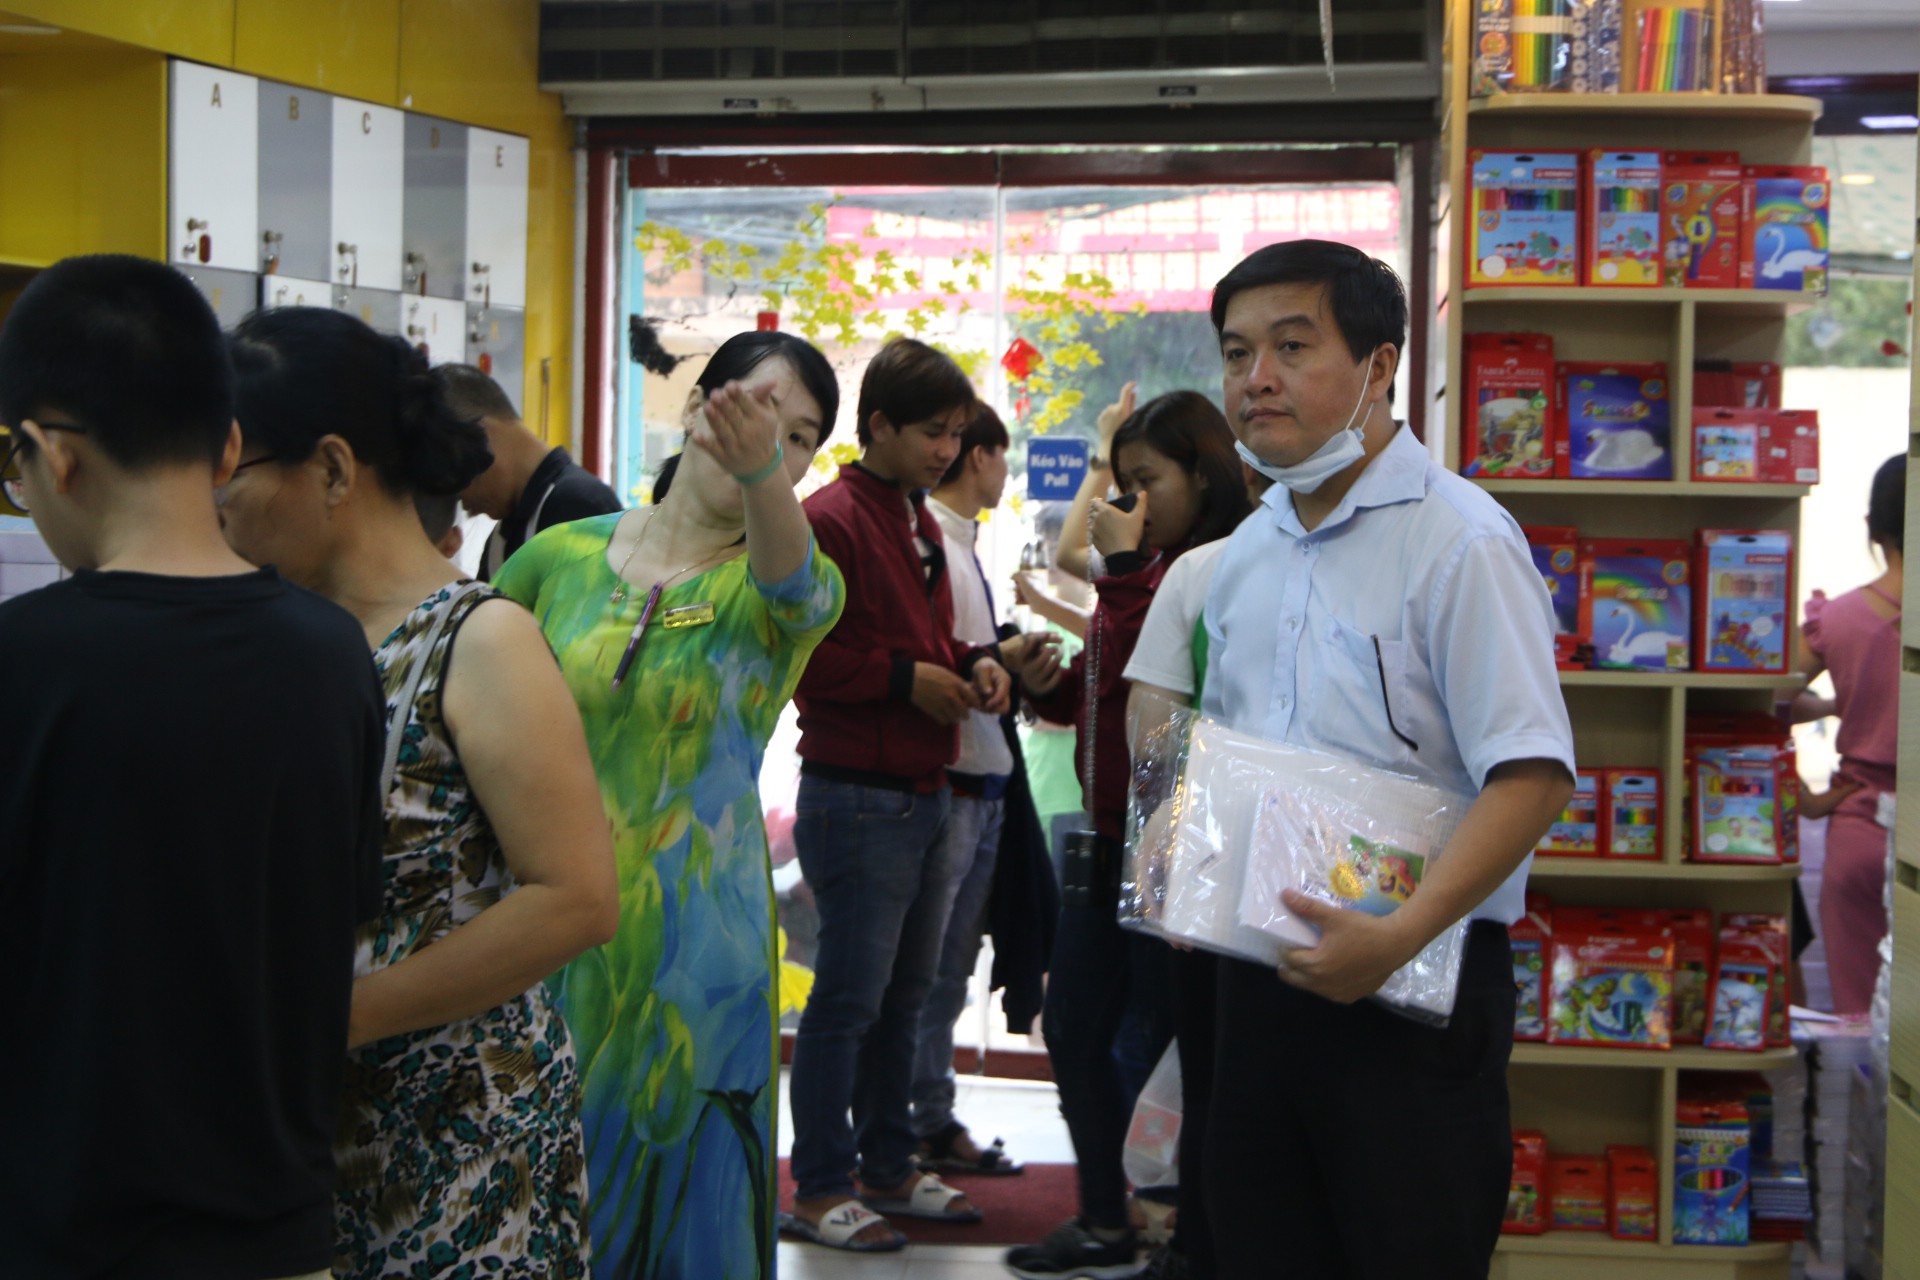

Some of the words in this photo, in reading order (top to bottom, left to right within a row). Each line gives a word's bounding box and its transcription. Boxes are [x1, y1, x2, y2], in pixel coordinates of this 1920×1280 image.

[210, 82, 222, 109] A
[288, 95, 300, 121] B
[362, 111, 371, 135] C
[496, 145, 504, 168] E
[1044, 472, 1069, 488] Pull
